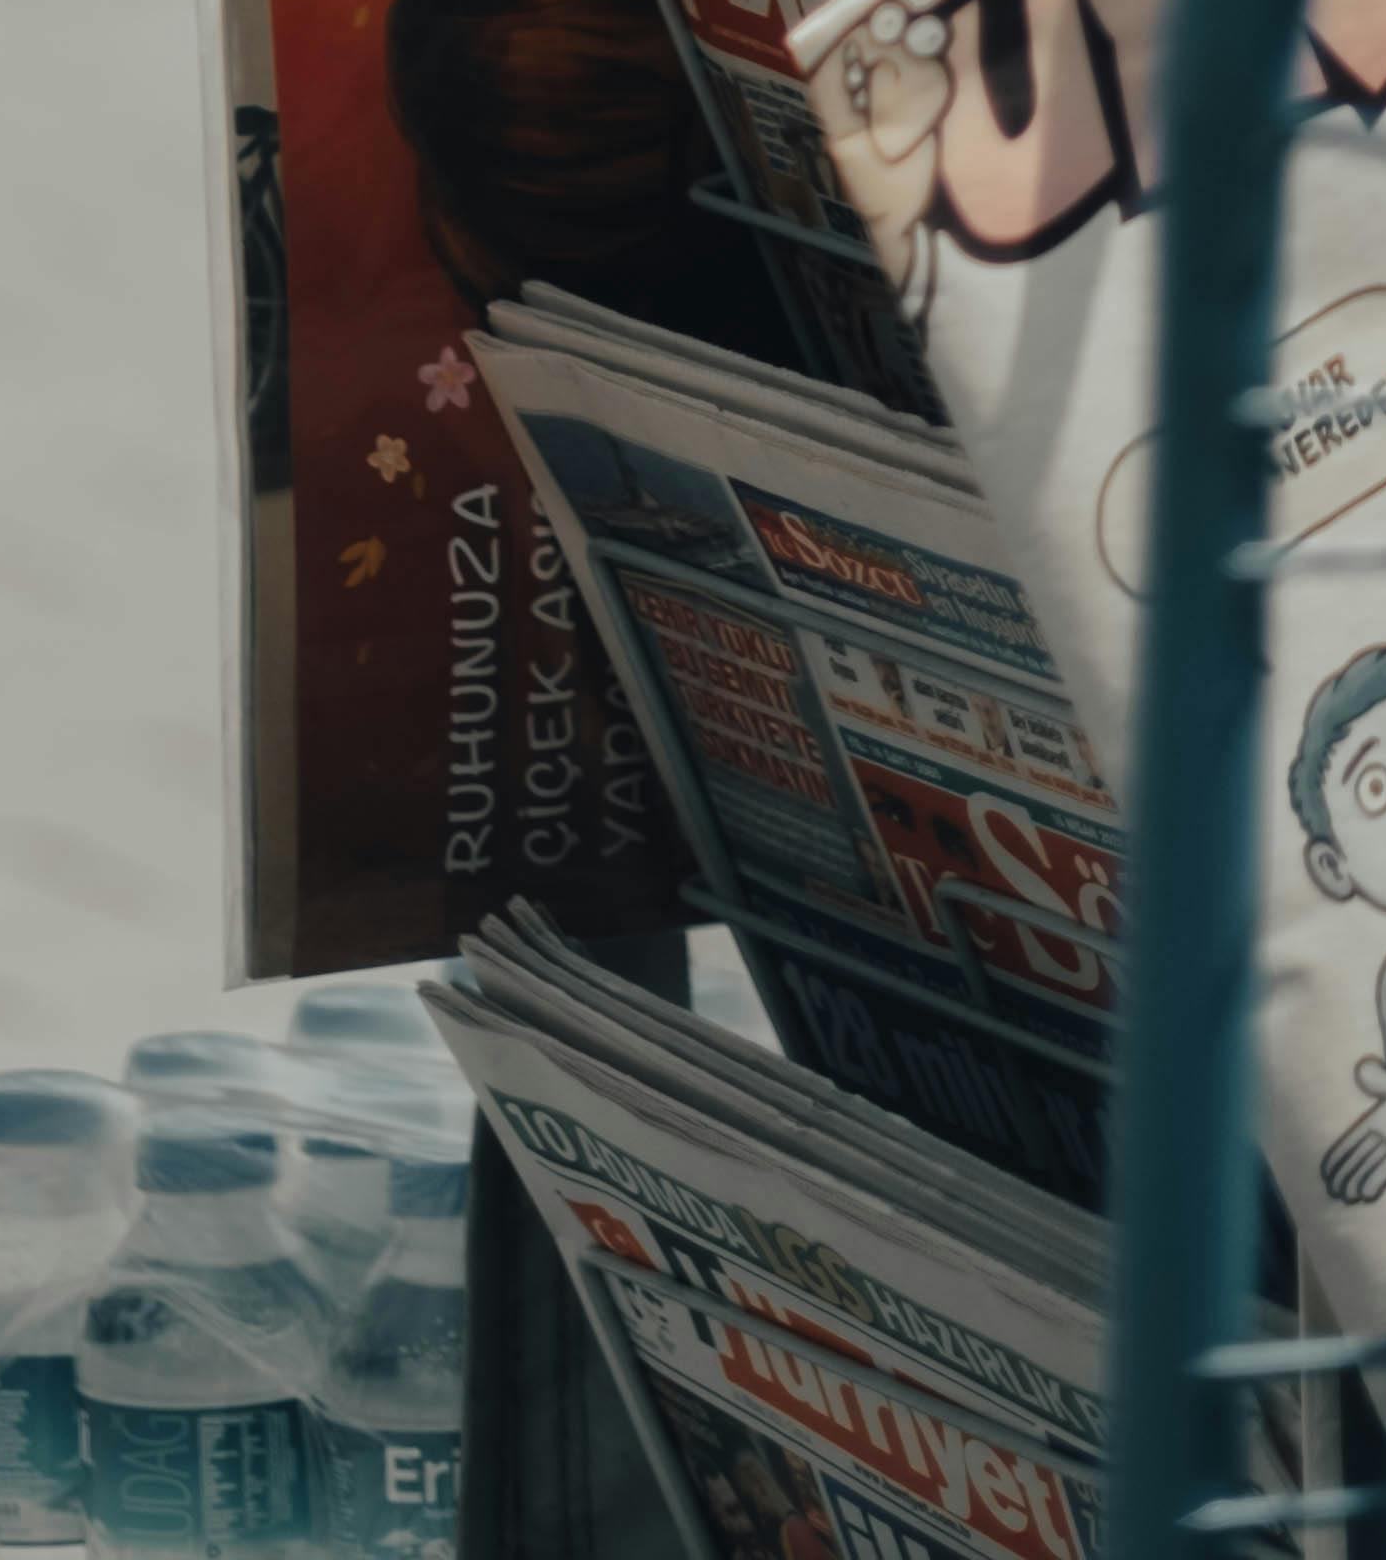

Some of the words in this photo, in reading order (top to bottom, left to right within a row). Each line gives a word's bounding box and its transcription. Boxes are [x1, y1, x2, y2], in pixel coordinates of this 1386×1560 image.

[446, 482, 500, 875] RUHUNUZA
[517, 652, 583, 866] ÇİÇEK
[505, 1102, 577, 1162] 10
[579, 1138, 759, 1256] ADIMDA
[729, 1207, 871, 1321] LGS
[864, 1279, 1068, 1410] HAZIRLIK
[386, 1446, 461, 1504] Eri
